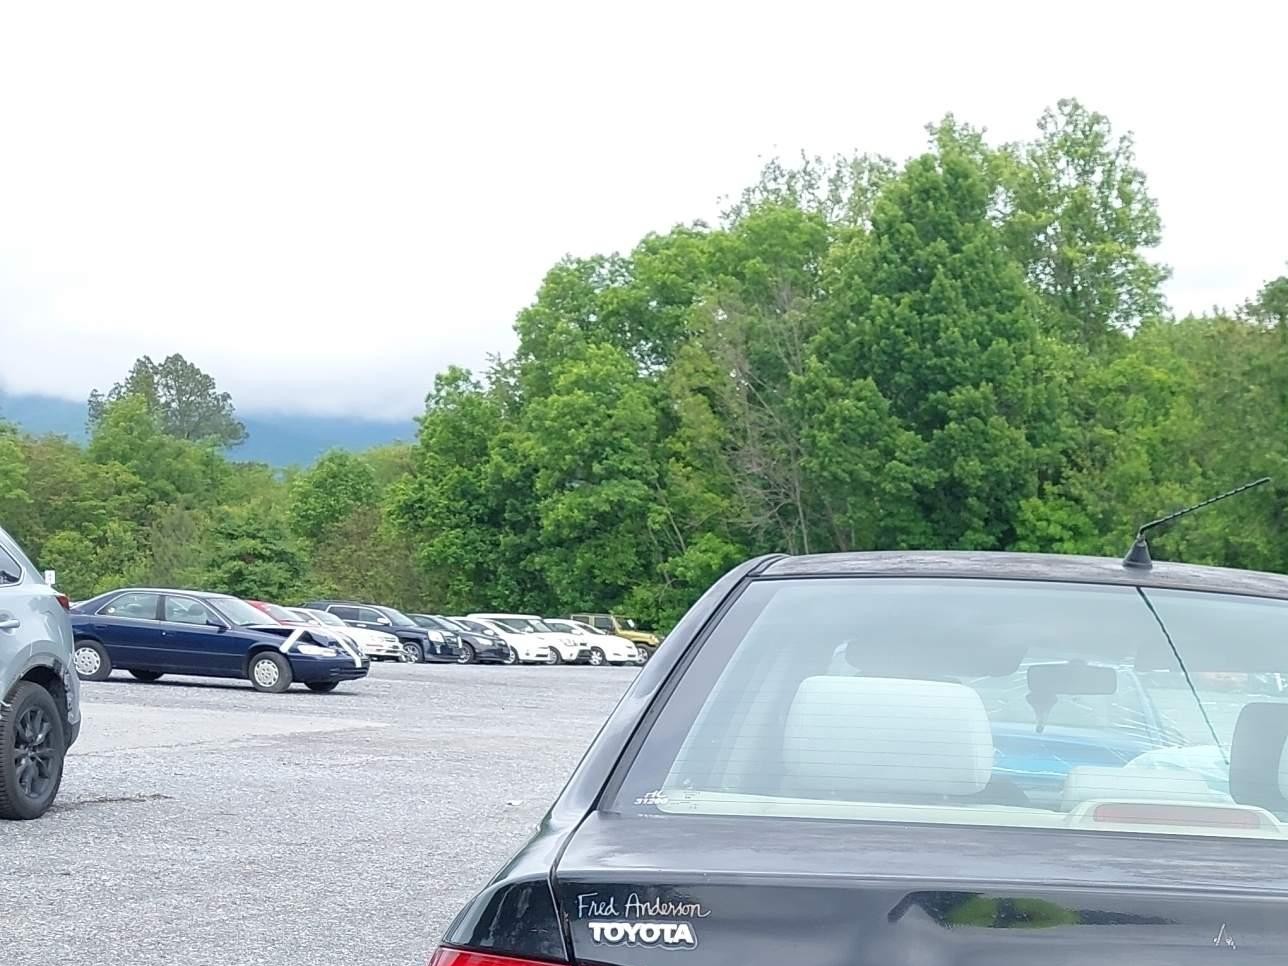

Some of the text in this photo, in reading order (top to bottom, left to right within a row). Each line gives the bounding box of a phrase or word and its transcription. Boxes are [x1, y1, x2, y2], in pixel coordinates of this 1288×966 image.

[577, 892, 711, 918] Fred Anderson
[588, 922, 694, 944] TOYOTA
